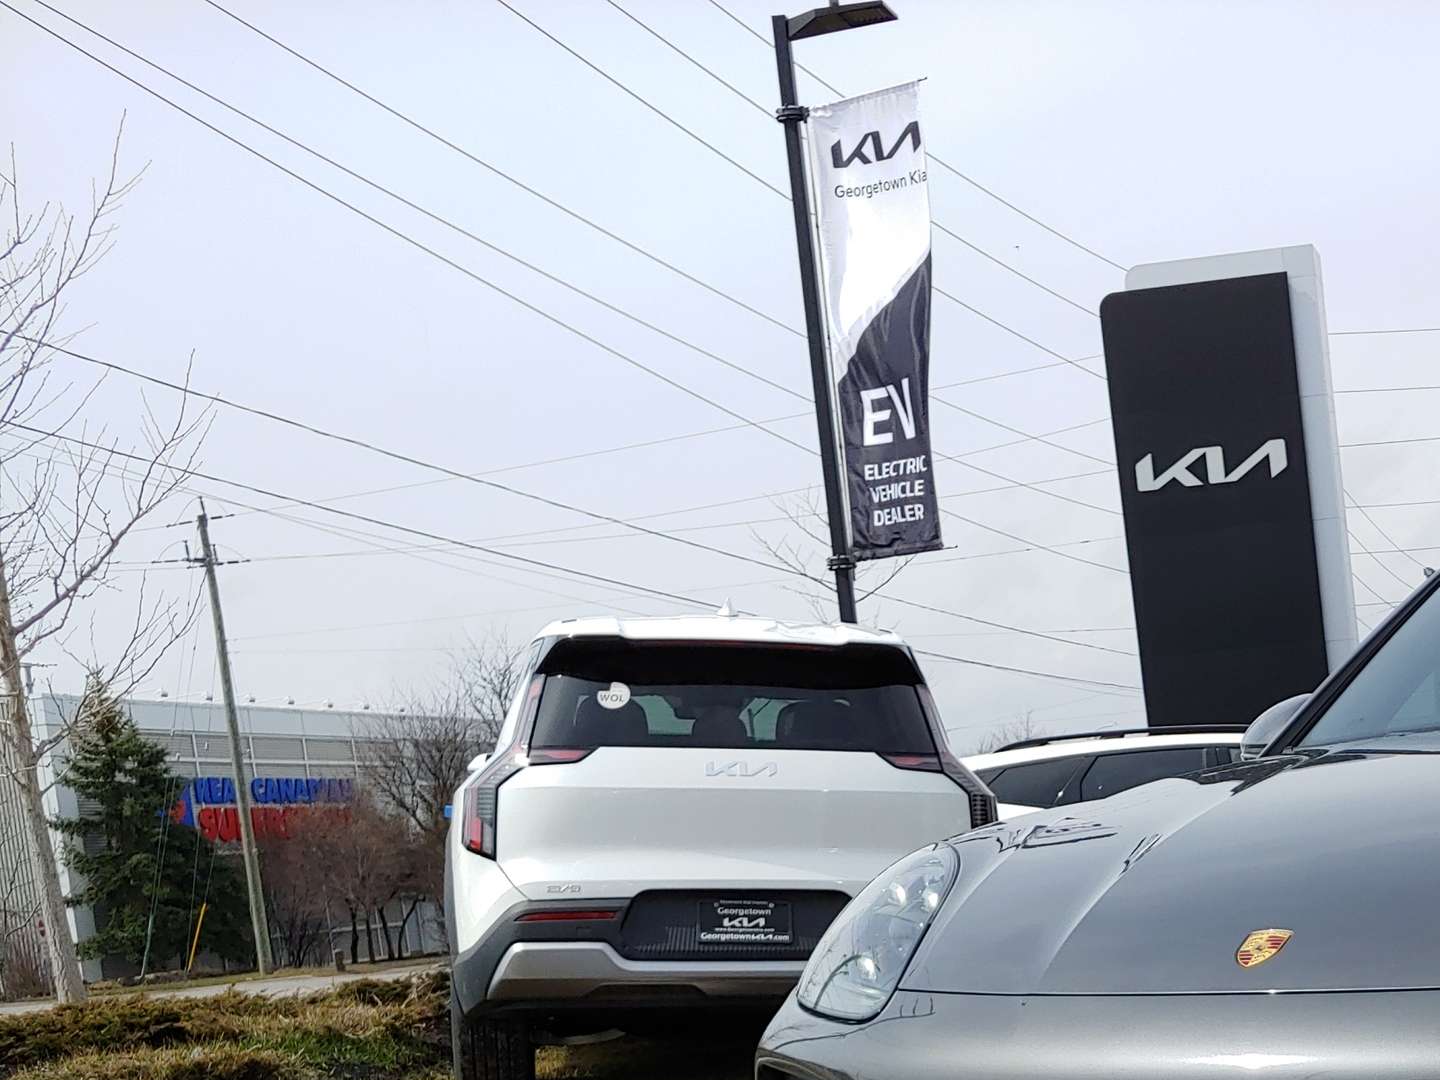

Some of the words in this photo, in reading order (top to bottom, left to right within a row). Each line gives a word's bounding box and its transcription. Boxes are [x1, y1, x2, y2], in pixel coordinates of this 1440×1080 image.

[831, 121, 921, 168] KIA
[834, 176, 907, 199] Georgetown
[909, 169, 927, 185] Kia
[860, 377, 915, 446] EV
[864, 455, 927, 481] ELECTRIC
[1135, 438, 1288, 492] KIA
[870, 479, 924, 503] VEHICLE
[873, 503, 924, 526] DEALER
[194, 777, 237, 804] REA
